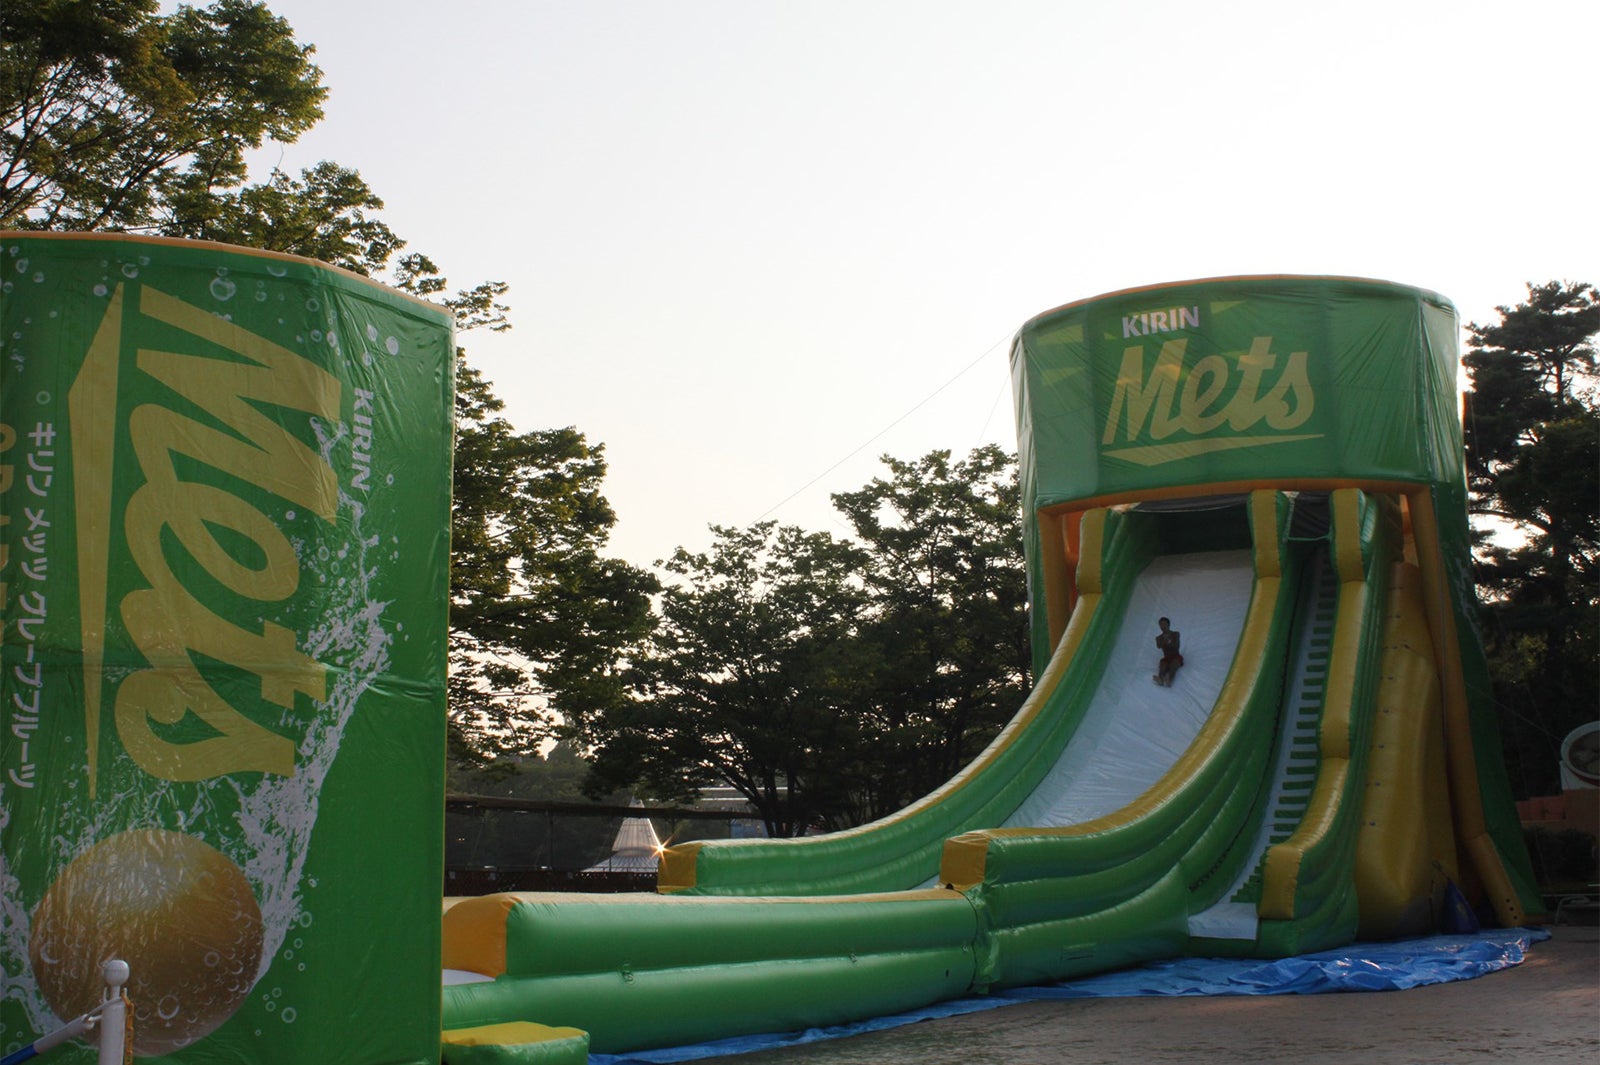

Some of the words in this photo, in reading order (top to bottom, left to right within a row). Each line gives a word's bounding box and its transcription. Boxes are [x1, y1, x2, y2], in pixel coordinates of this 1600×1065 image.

[1122, 306, 1200, 337] KIRIN
[351, 387, 374, 491] KIRIN
[1101, 336, 1315, 445] Mets
[27, 421, 56, 497] キリン
[20, 507, 51, 581] メッツ
[114, 284, 342, 783] Mets
[8, 591, 47, 788] グレープフルーツ
